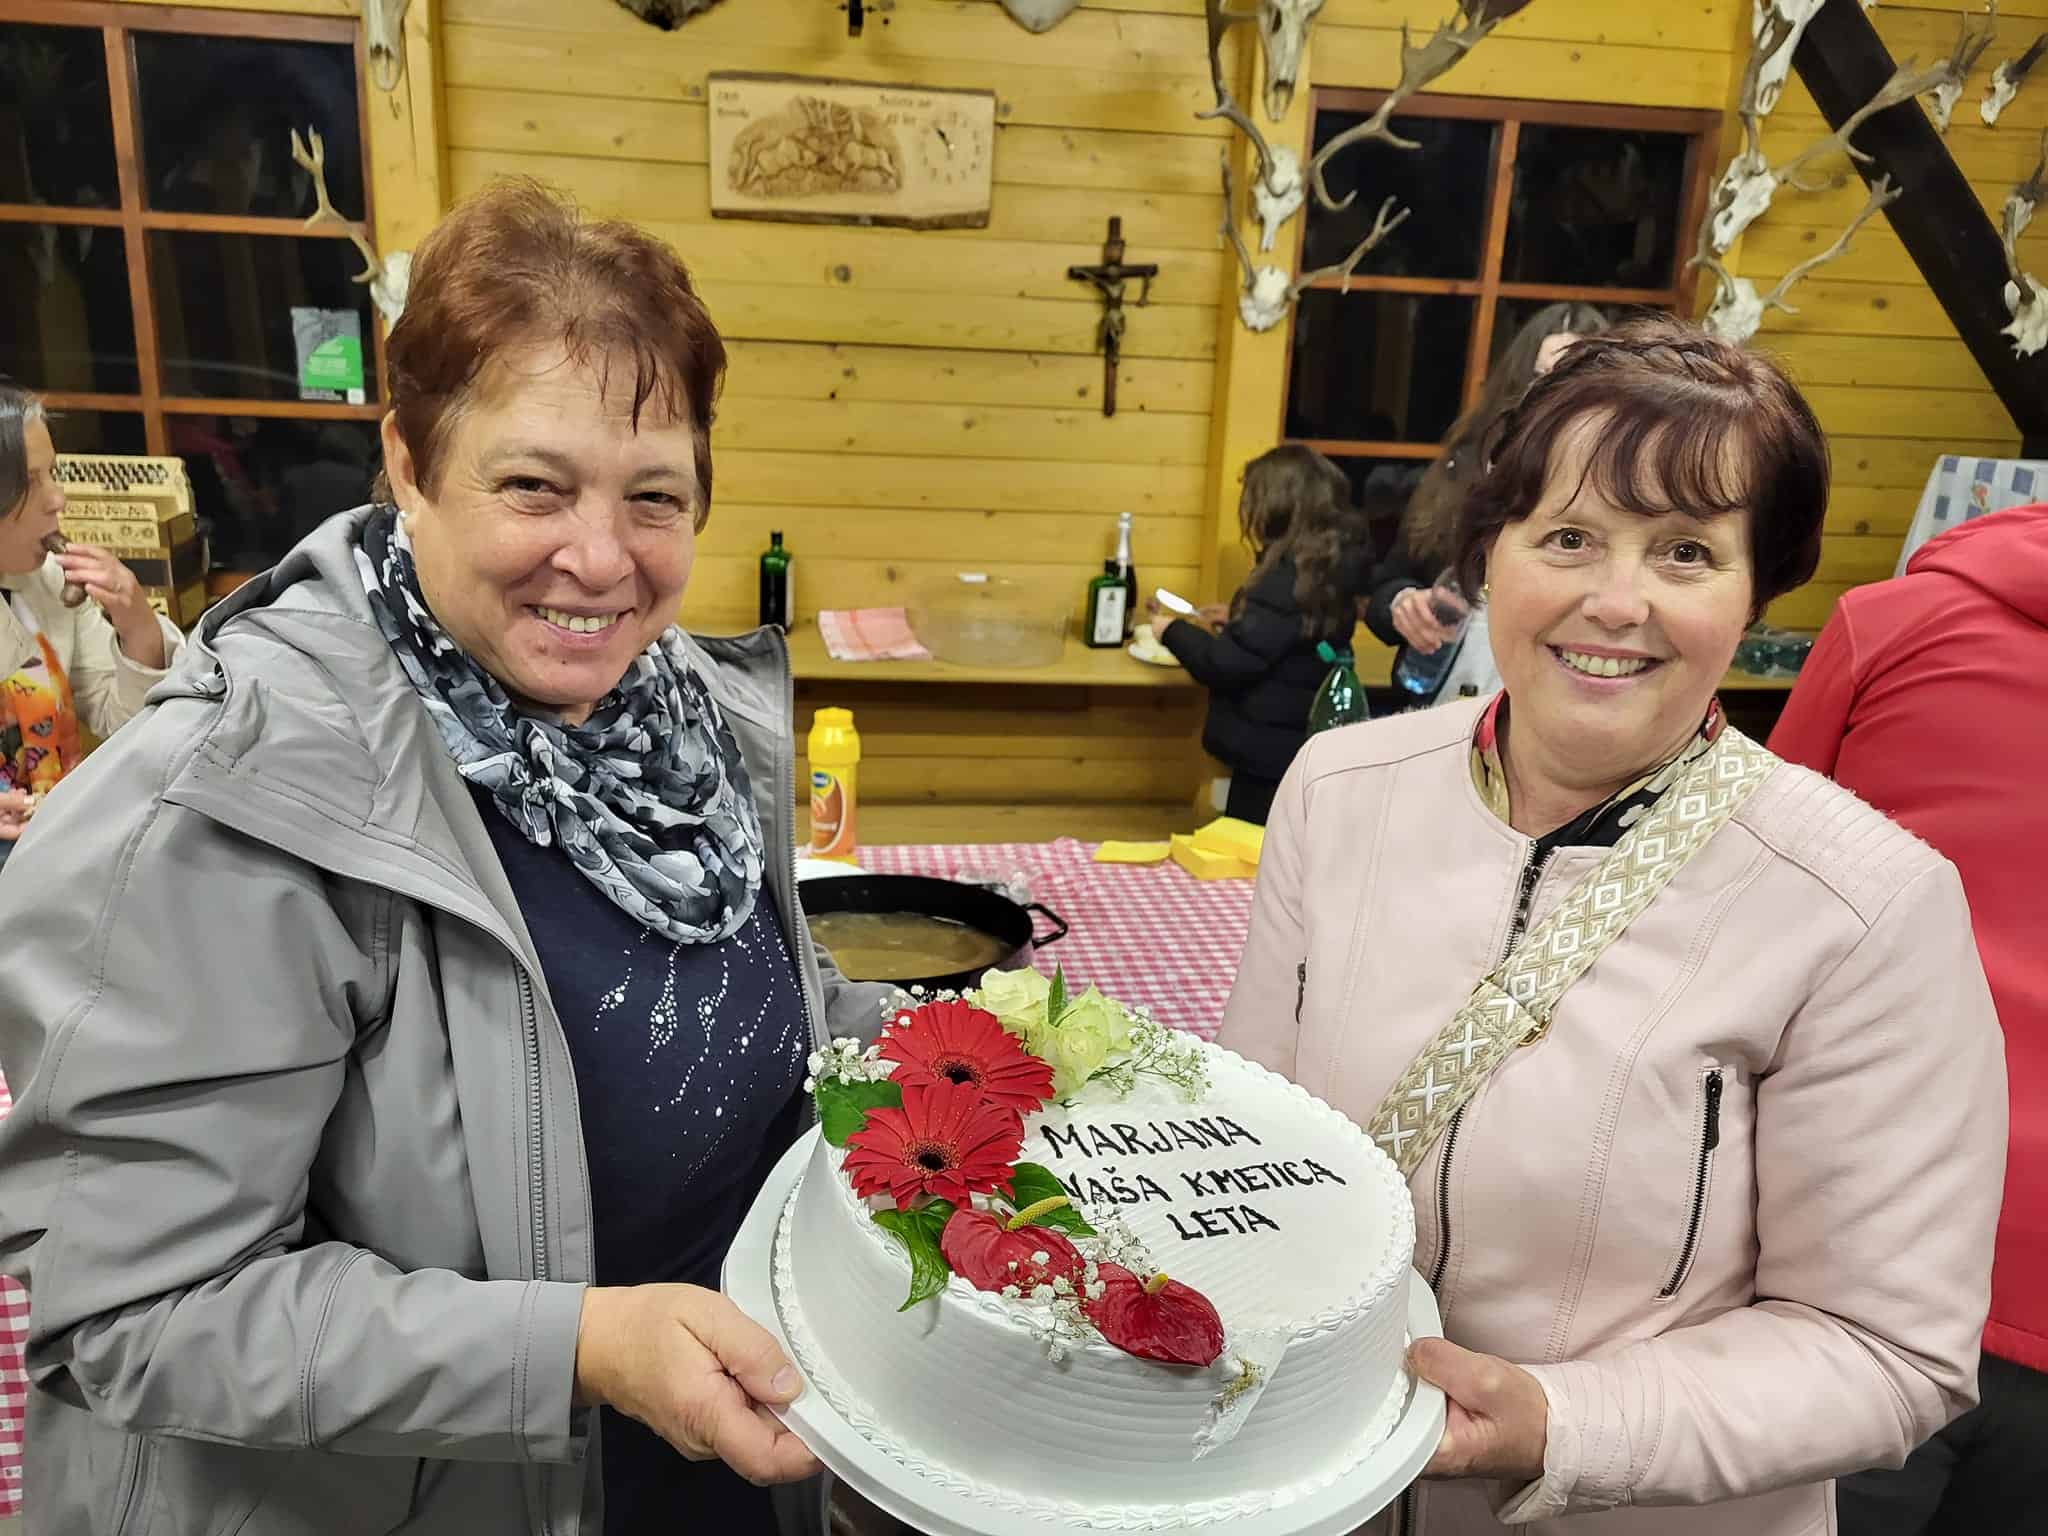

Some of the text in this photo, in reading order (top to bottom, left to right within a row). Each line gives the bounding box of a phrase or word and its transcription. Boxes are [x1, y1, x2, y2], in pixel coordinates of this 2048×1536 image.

[1040, 1116, 1262, 1158] MARJANA
[1056, 1158, 1346, 1205] VAŠA KMETICA
[1166, 1204, 1281, 1240] LETA
